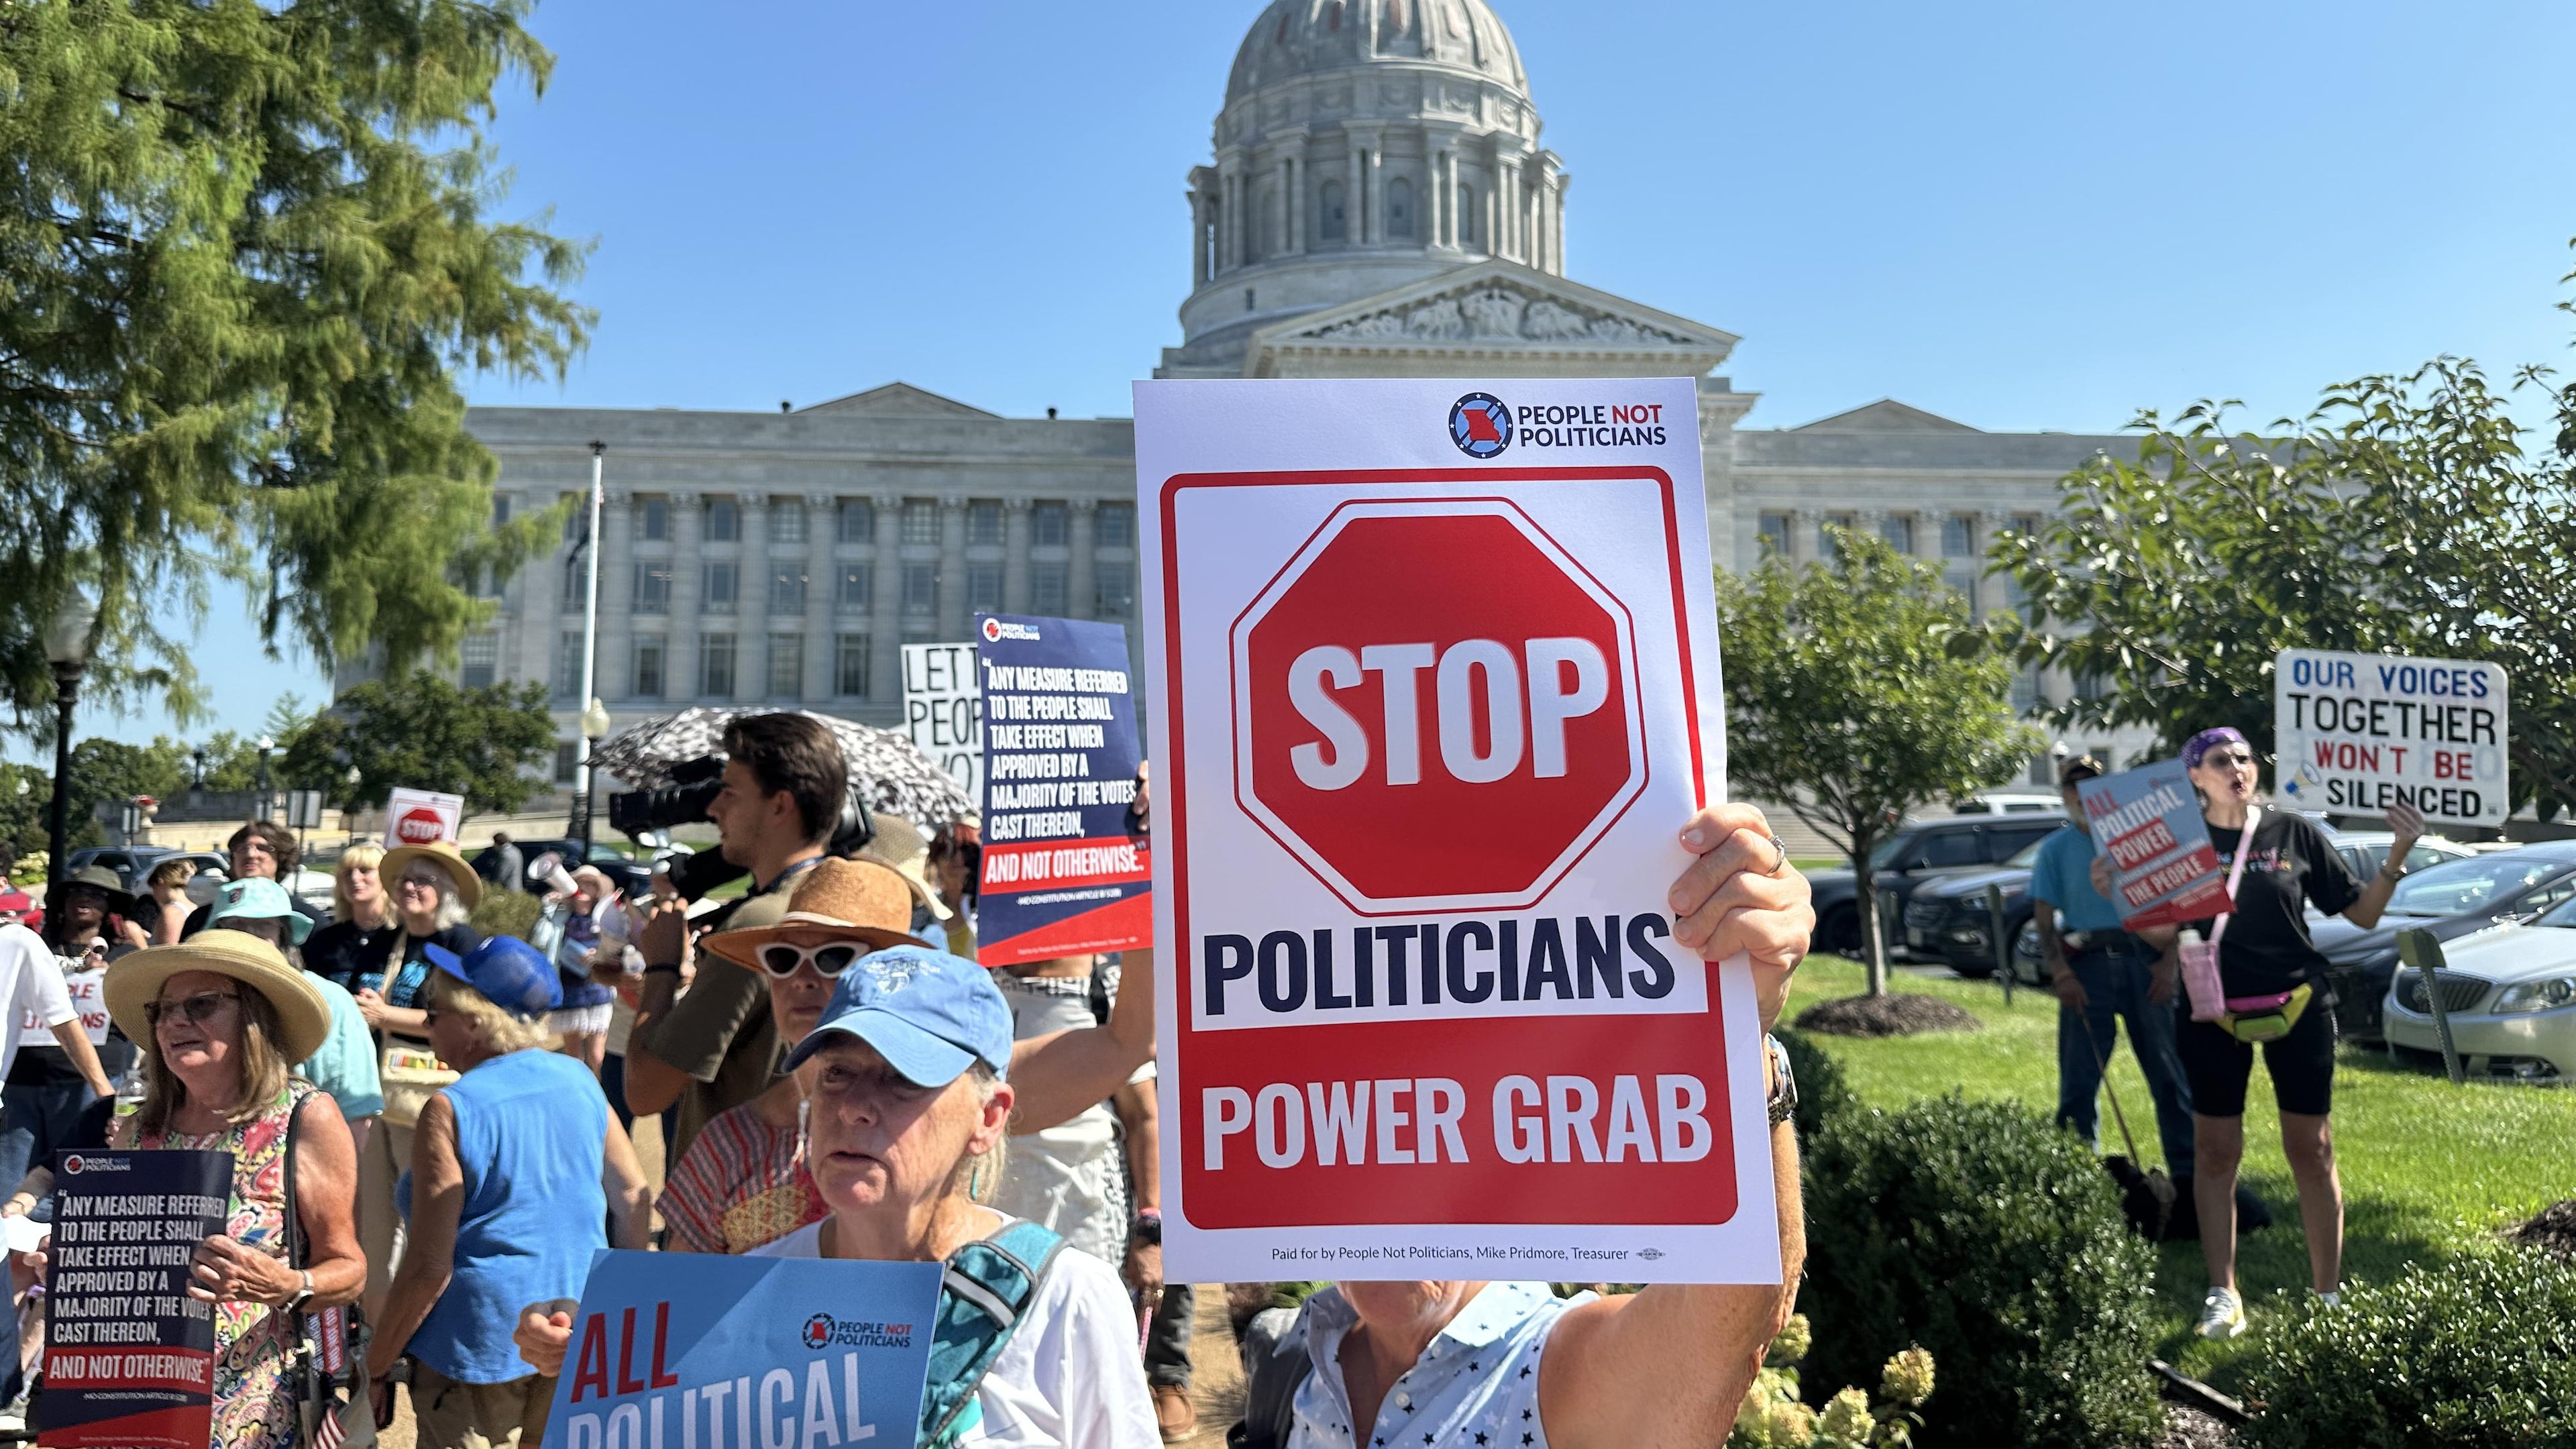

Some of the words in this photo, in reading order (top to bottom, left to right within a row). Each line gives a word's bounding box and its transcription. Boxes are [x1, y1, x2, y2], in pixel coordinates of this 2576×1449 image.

[1518, 405, 1607, 425] PEOPLE
[1612, 405, 1662, 424] NOT
[1519, 427, 1667, 447] POLITICIANS
[906, 647, 961, 692] LET
[1016, 666, 1075, 692] MEASURE
[1074, 668, 1128, 694] REFERRED
[2293, 657, 2355, 691] OUR
[2378, 663, 2489, 698] VOICES
[910, 698, 983, 746] PEOP
[988, 695, 1006, 720] TO
[1007, 695, 1032, 720] THE
[1032, 696, 1077, 720] PEOPLE
[1077, 696, 1114, 720] SHALL
[1287, 637, 1610, 792] STOP
[2288, 692, 2496, 747] TOGETHER
[989, 724, 1023, 749] TAKE
[1024, 724, 1067, 749] EFFECT
[1067, 724, 1104, 748] WHEN
[991, 753, 1060, 780] APPROVED
[1061, 753, 1079, 777] BY
[1079, 753, 1089, 777] A
[2314, 740, 2408, 775] WON'T
[2434, 749, 2473, 781] BE
[991, 782, 1059, 810] MAJORITY
[1059, 782, 1076, 807] OF
[1076, 781, 1099, 806] THE
[1100, 780, 1136, 804] VOTES
[2085, 788, 2119, 818] ALL
[2326, 777, 2481, 818] SILENCED
[990, 813, 1026, 841] CAST
[1025, 810, 1085, 839] THEREON,
[2094, 784, 2186, 842] POLITICAL
[402, 818, 444, 840] STOP
[2109, 822, 2174, 868] POWER
[984, 853, 1020, 884] AND
[1021, 851, 1053, 881] NOT
[2124, 878, 2154, 907] THE
[2149, 854, 2206, 896] PEOPLE
[1204, 912, 1682, 1016] POLITICIANS
[1202, 1077, 1470, 1171] POWER
[1491, 1074, 1713, 1164] GRAB
[94, 1194, 165, 1216] MEASURE
[168, 1194, 226, 1220] REFERRED
[60, 1221, 78, 1242] TO
[80, 1221, 107, 1242] THE
[109, 1220, 162, 1241] PEOPLE
[165, 1220, 205, 1241] SHALL
[57, 1246, 94, 1268] TAKE
[96, 1246, 147, 1267] EFFECT
[148, 1245, 191, 1266] WHEN
[1272, 1246, 1297, 1260] Paid
[1301, 1246, 1318, 1259] for
[1321, 1246, 1336, 1263] by
[1338, 1246, 1379, 1262] People
[1383, 1246, 1406, 1259] Not
[1409, 1246, 1473, 1261] Politicians,
[1477, 1246, 1506, 1259] Mike
[1509, 1246, 1568, 1261] Pridmore,
[1570, 1246, 1629, 1260] Treasurer
[55, 1271, 134, 1293] APPROVED
[137, 1271, 155, 1291] BY
[158, 1271, 169, 1291] A
[54, 1295, 131, 1318] MAJORITY
[133, 1295, 152, 1318] OF
[154, 1295, 179, 1317] THE
[53, 1322, 92, 1343] CAST
[92, 1321, 162, 1345] THEREON,
[835, 1333, 912, 1348] POLITICIANS
[838, 1321, 884, 1334] PEOPLE
[885, 1323, 912, 1335] NOT
[49, 1355, 86, 1379] AND
[89, 1354, 123, 1379] NOT
[570, 1301, 679, 1403] ALL
[567, 1352, 876, 1449] POLITICAL
